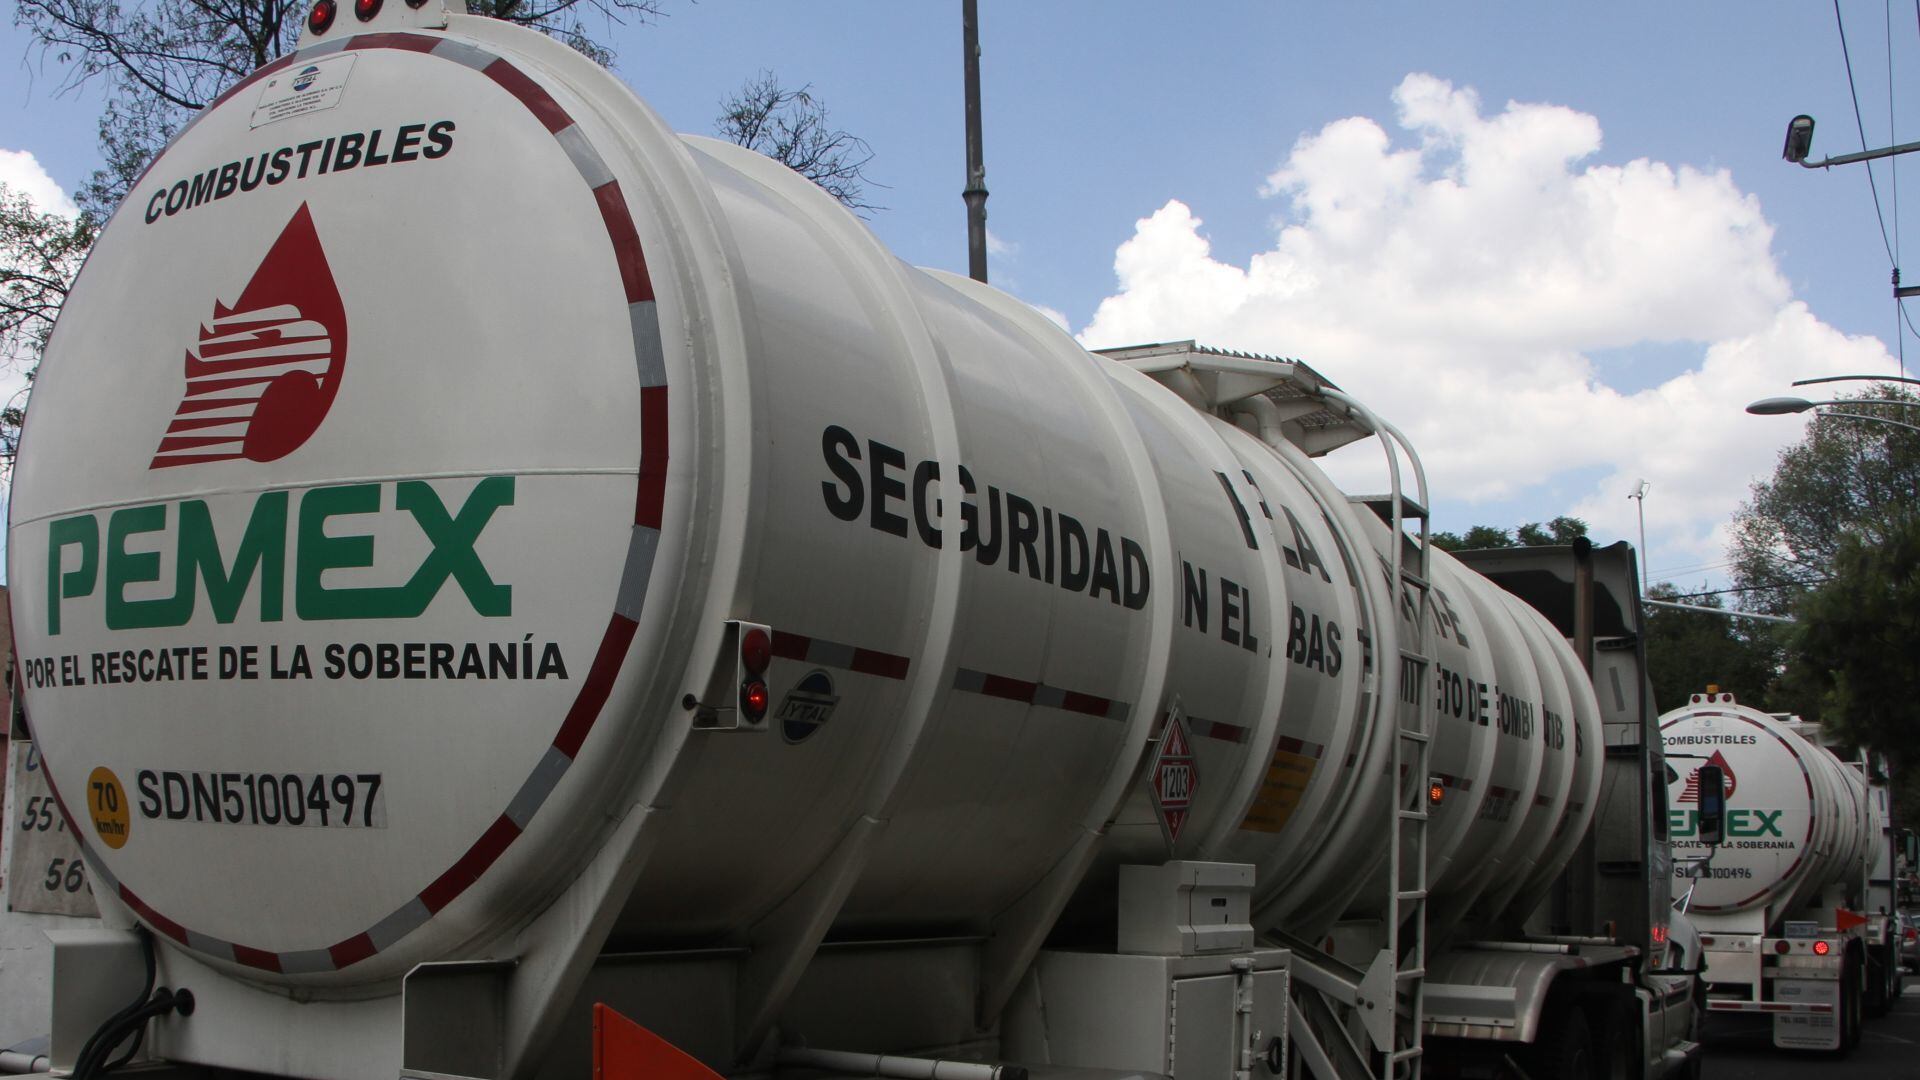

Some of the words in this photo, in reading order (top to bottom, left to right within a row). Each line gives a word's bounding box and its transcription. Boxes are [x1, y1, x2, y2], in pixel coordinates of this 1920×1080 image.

[144, 120, 456, 225] COMBUSTIBLES
[821, 424, 1151, 611] SEGURIDAD
[48, 475, 516, 637] PEMEX
[26, 655, 56, 689] POR
[61, 654, 86, 687] EL
[92, 647, 209, 684] RESCATE
[219, 645, 259, 681] DE
[270, 644, 313, 680] LA
[324, 633, 570, 681] SOBERANÍA
[1220, 577, 1258, 654] EL
[1467, 677, 1489, 728] DE
[93, 780, 118, 814] 70
[136, 769, 383, 828] SDN5100497
[1163, 767, 1189, 799] 1203
[96, 816, 127, 837] km/hr
[1721, 840, 1734, 849] LA
[1736, 837, 1796, 849] SOBERANÍA
[45, 857, 94, 896] 56
